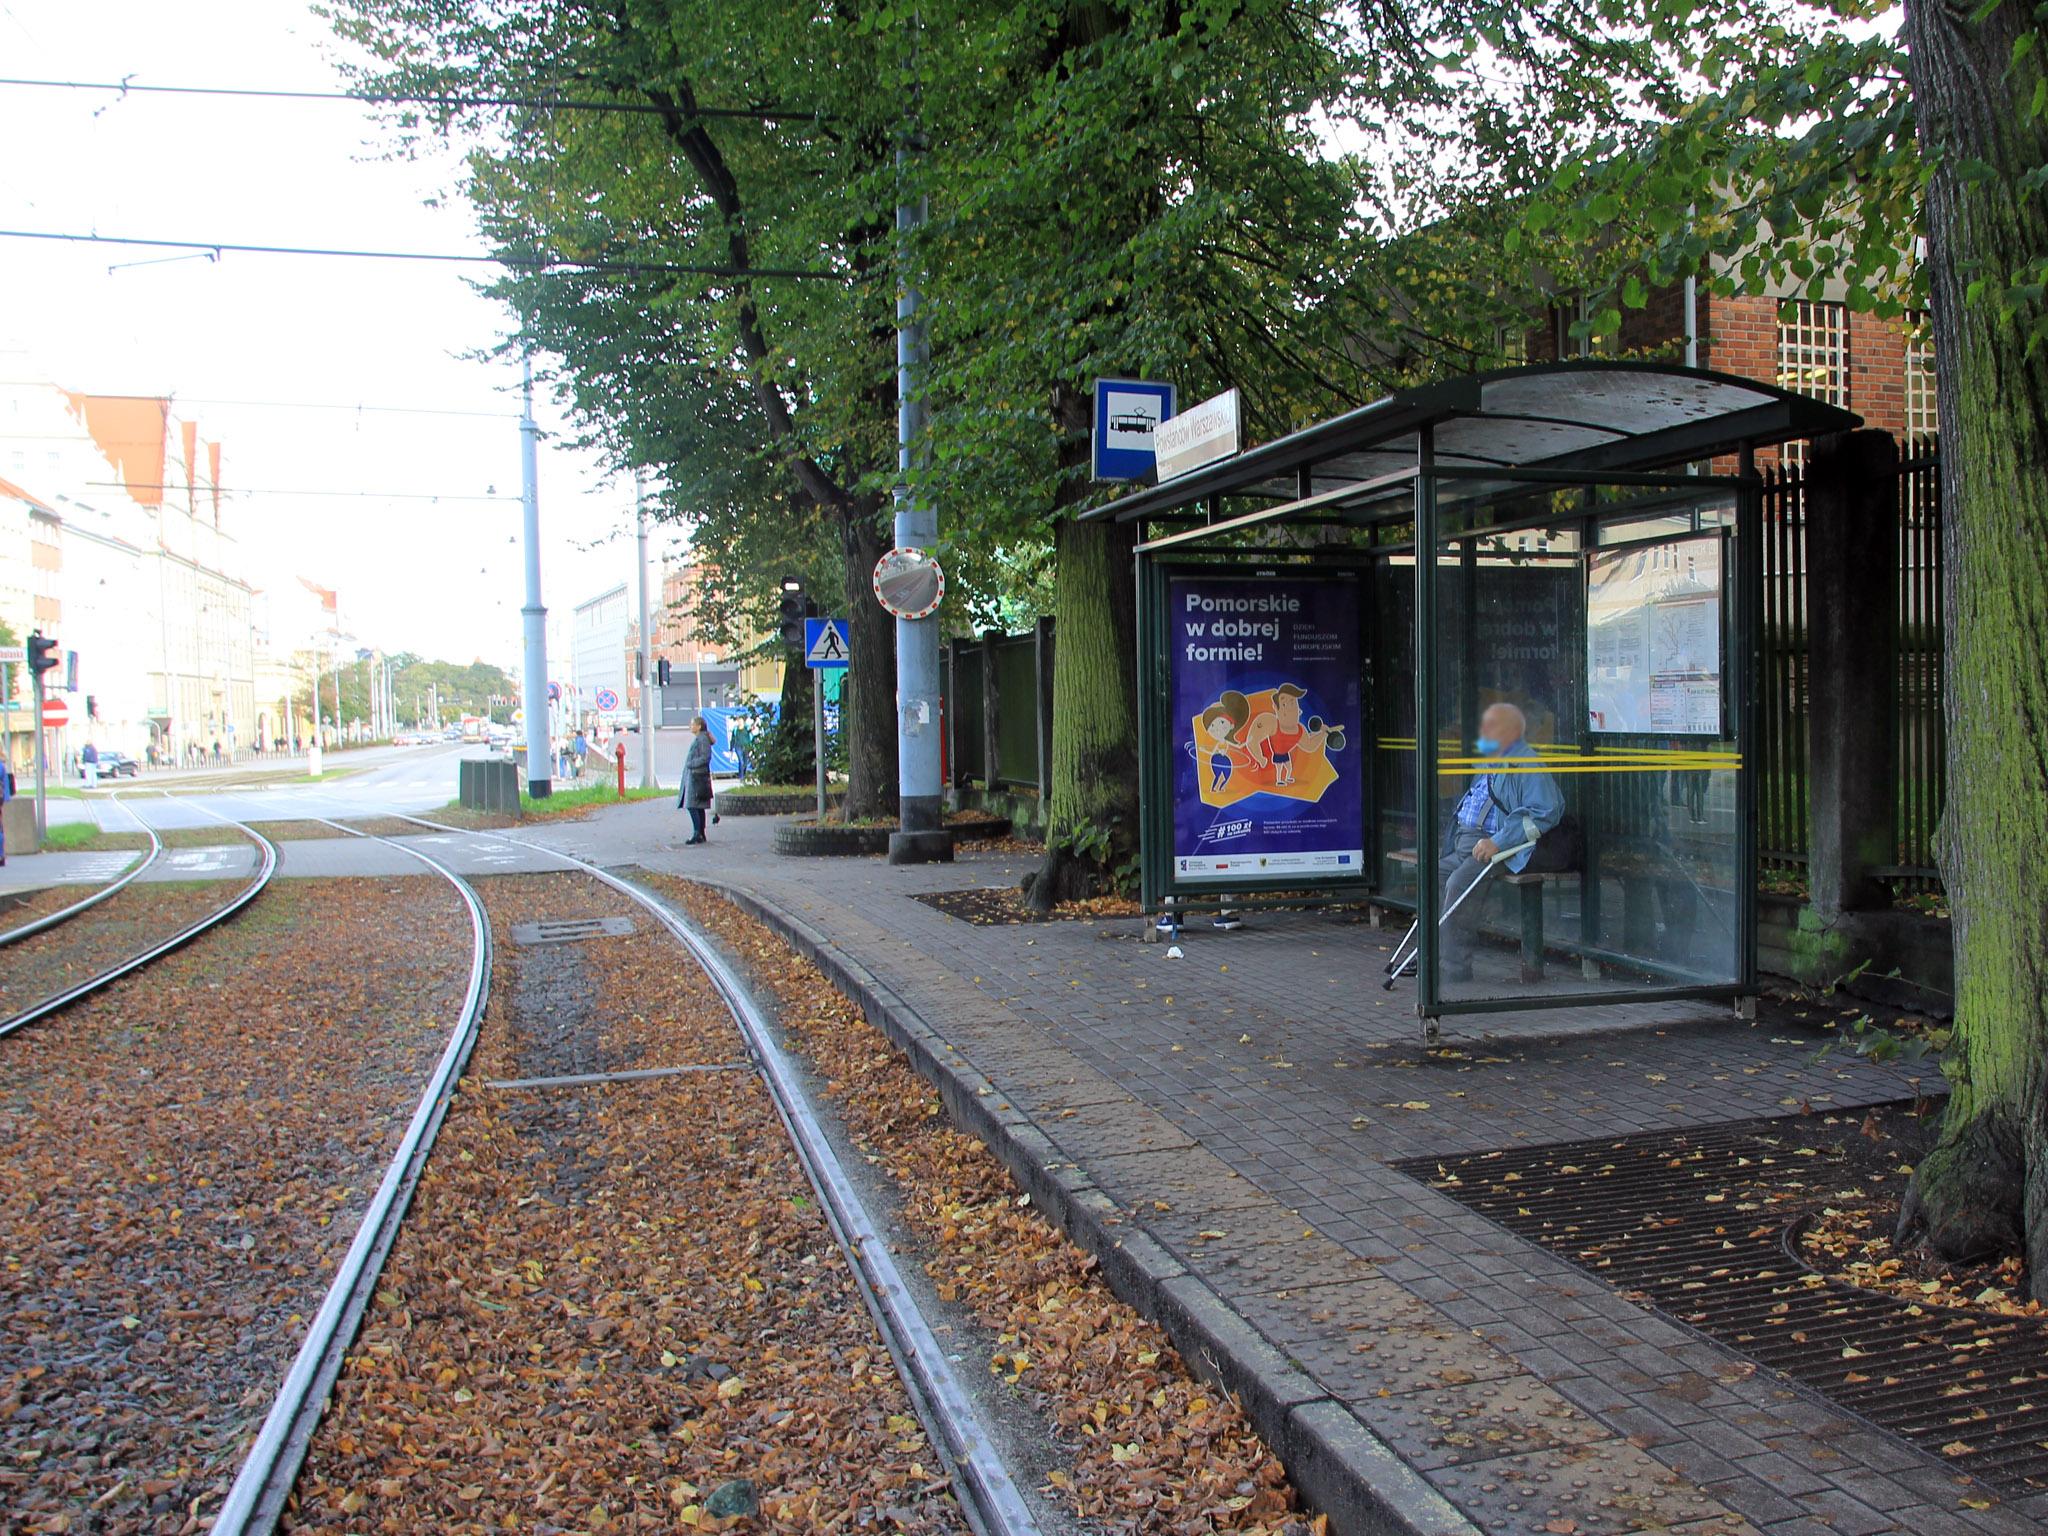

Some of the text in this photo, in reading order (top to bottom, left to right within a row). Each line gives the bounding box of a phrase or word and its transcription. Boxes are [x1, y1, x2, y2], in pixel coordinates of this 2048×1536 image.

[1186, 593, 1300, 612] Pomorskie
[1185, 618, 1280, 641] w dobrej
[1185, 642, 1264, 661] formie!
